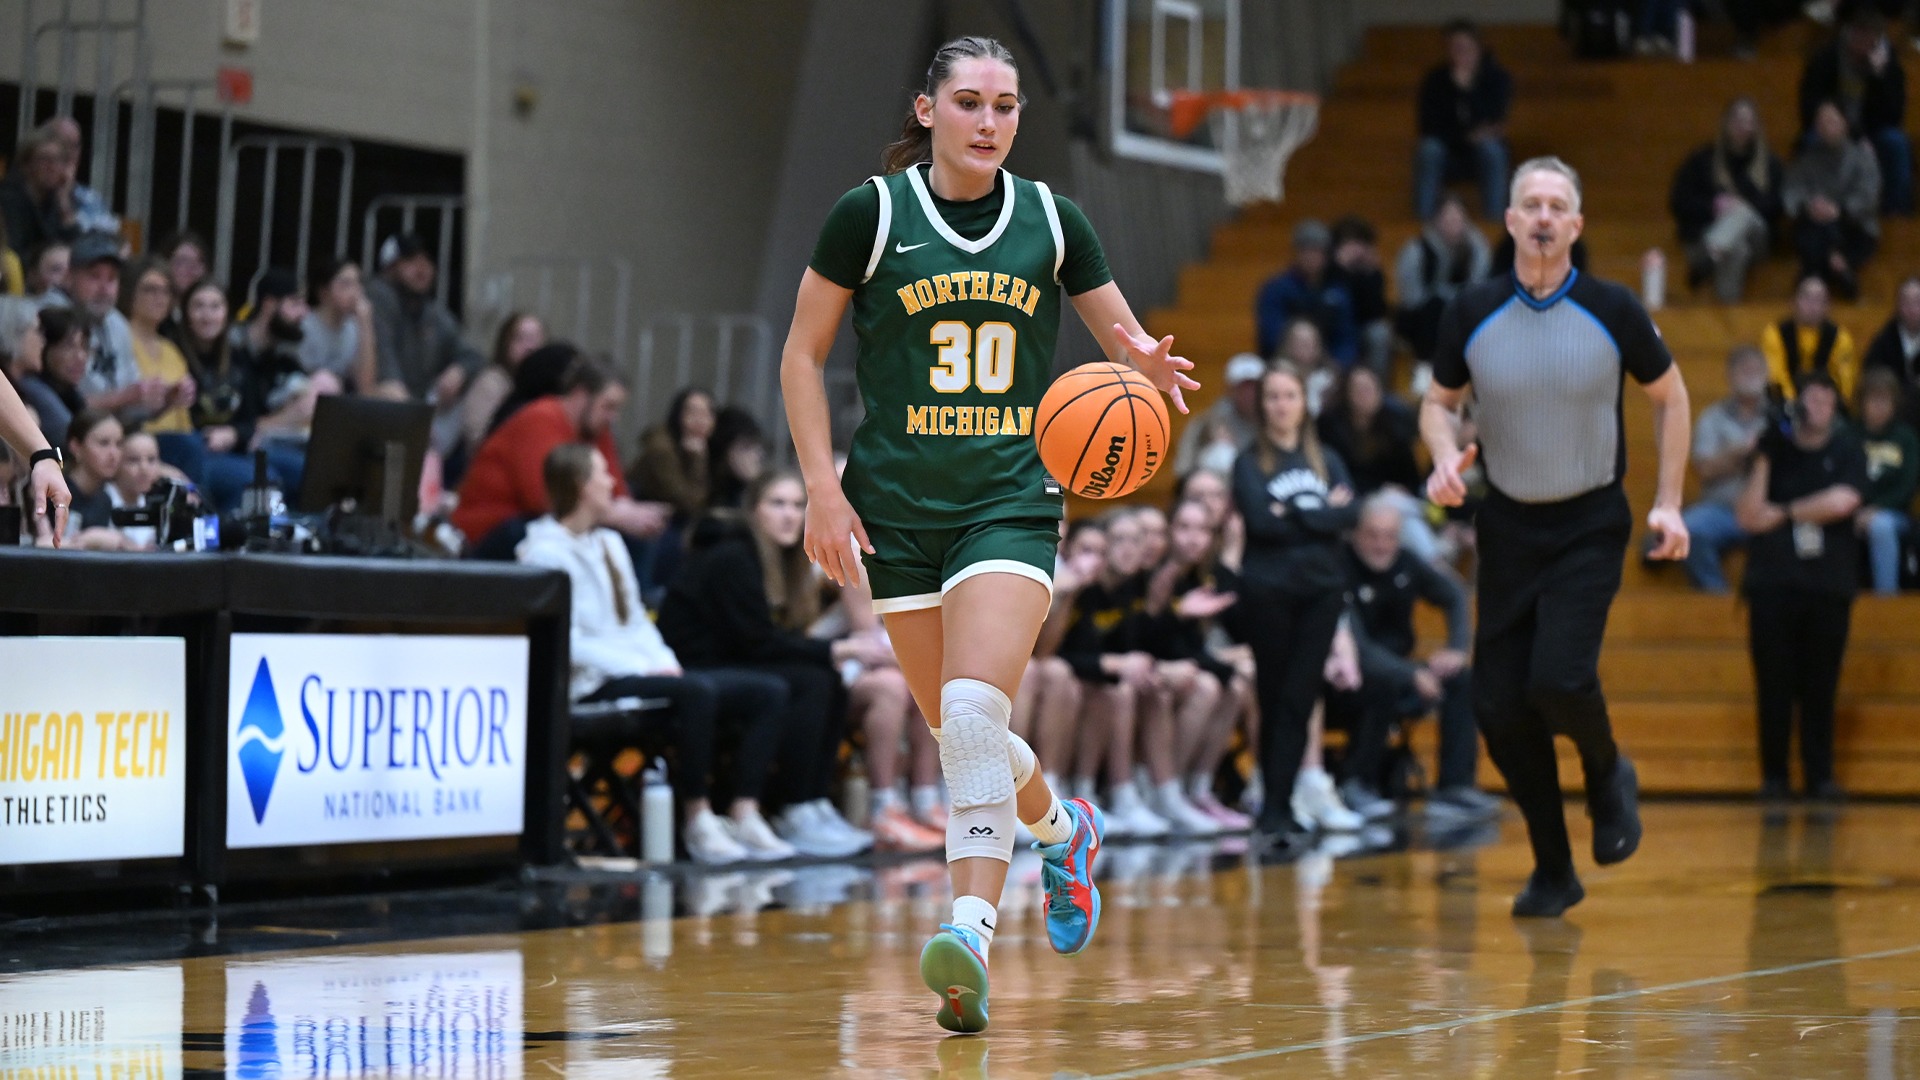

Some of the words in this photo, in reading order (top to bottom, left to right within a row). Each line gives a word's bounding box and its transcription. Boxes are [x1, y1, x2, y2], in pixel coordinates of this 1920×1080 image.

[897, 271, 1041, 317] NORTHERN
[929, 320, 1017, 394] 30
[906, 404, 1034, 436] MICHIGAN
[1079, 435, 1126, 497] Wilson
[95, 710, 170, 780] TECH
[297, 673, 512, 781] SUPERIOR
[324, 789, 421, 819] NATIONAL
[433, 787, 482, 816] BANK
